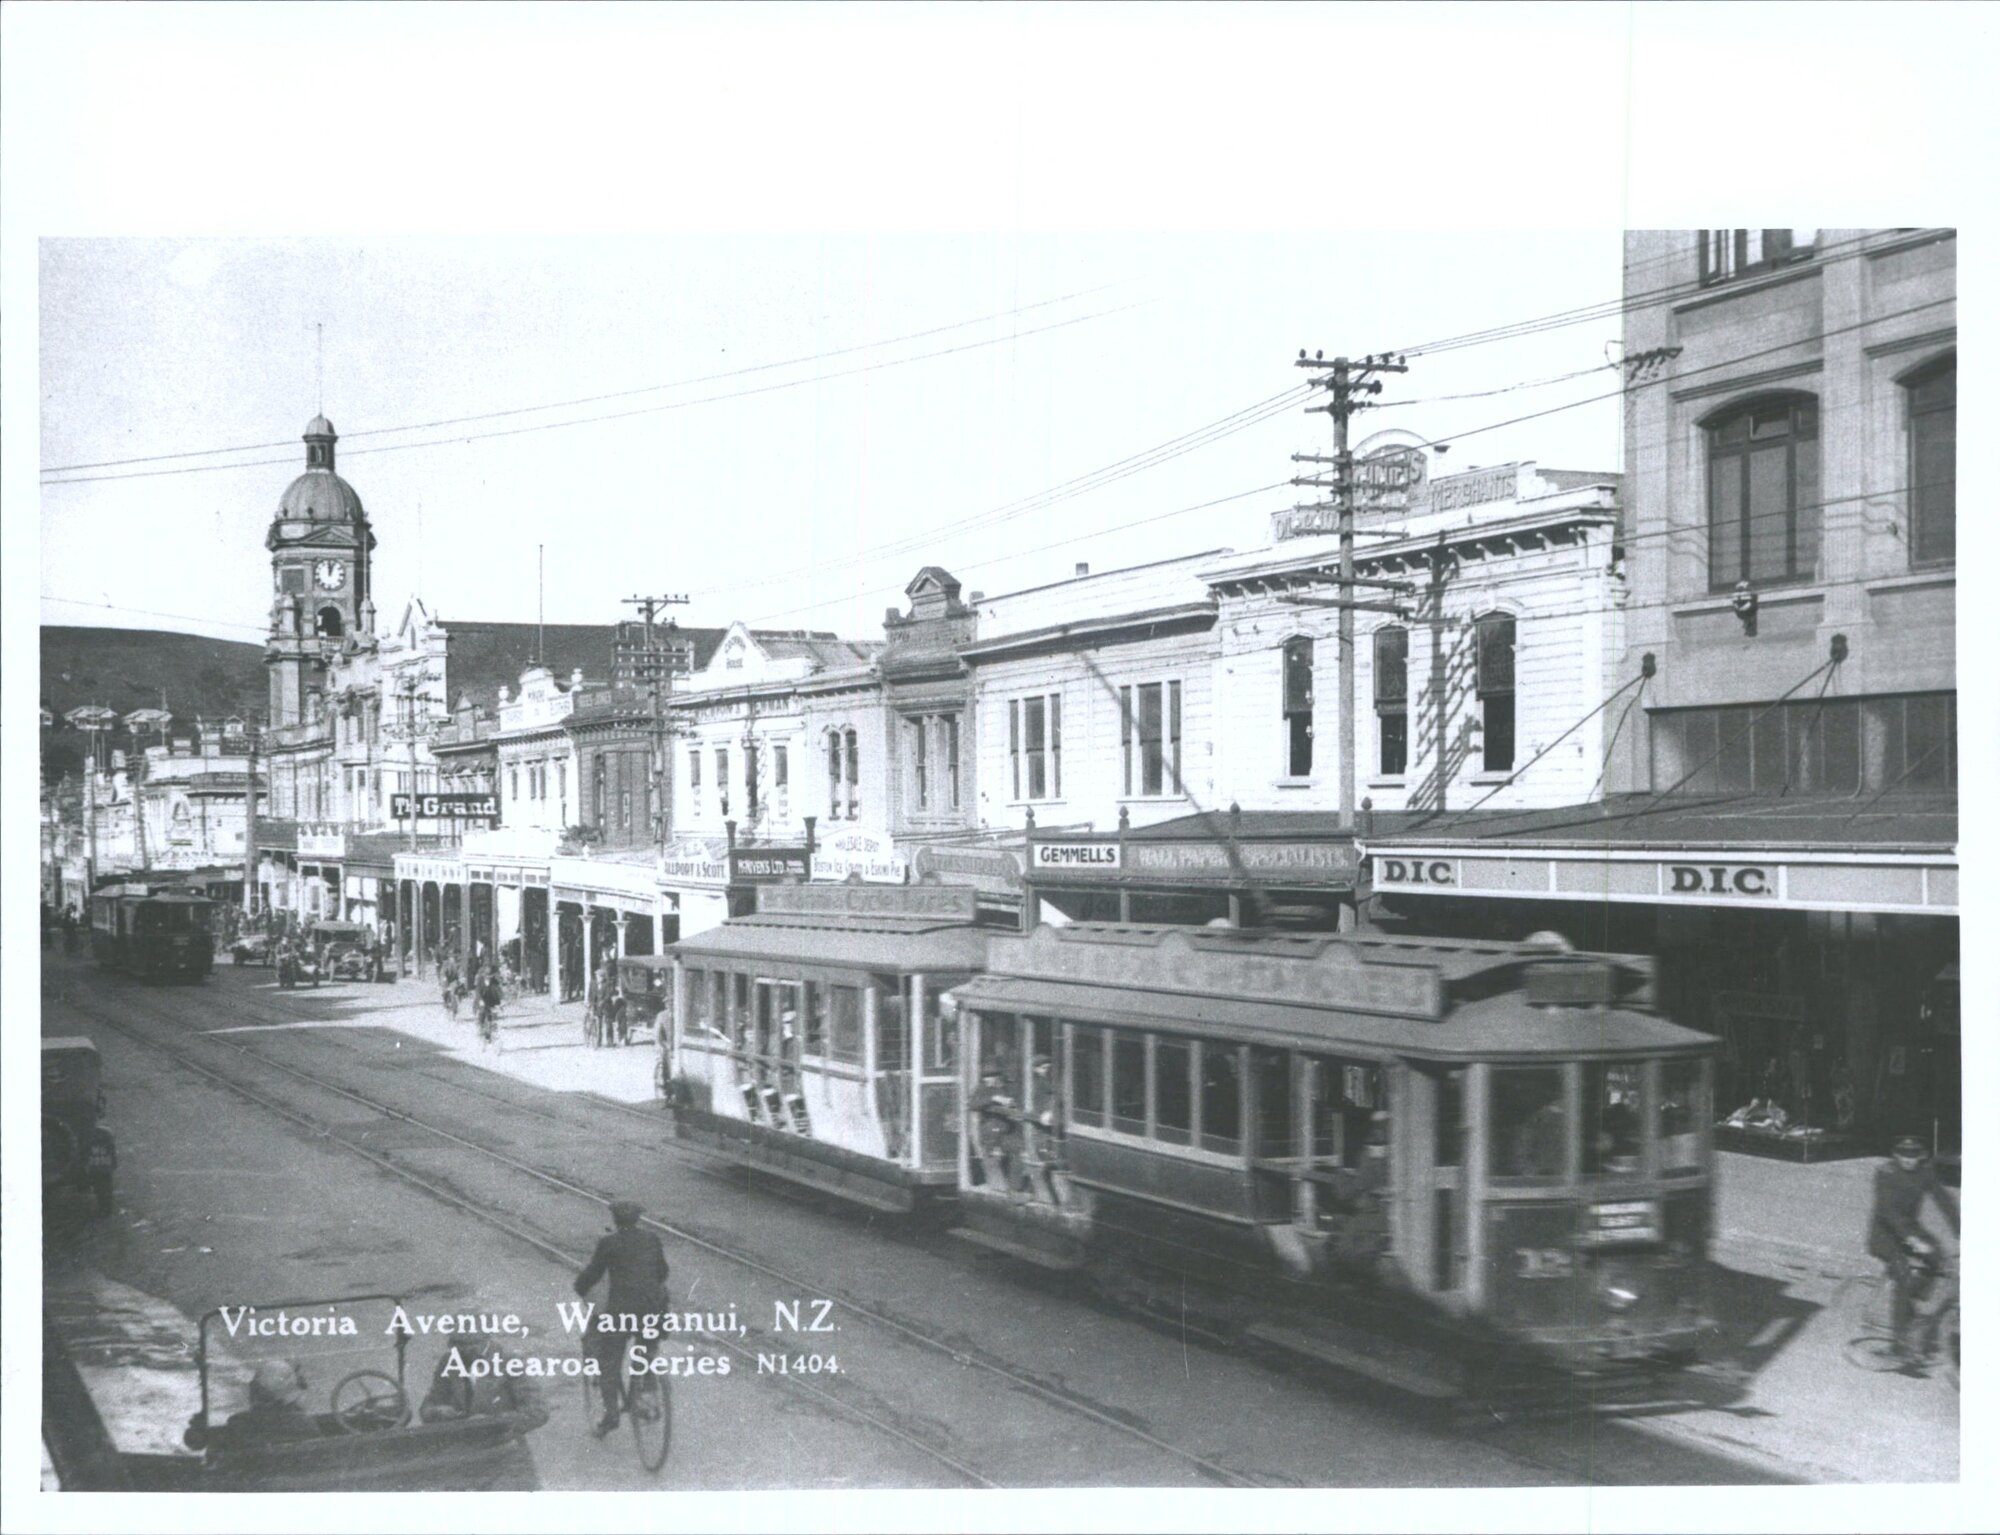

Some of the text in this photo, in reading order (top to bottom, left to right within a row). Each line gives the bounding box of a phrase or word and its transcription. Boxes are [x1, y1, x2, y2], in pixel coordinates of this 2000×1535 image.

[423, 797, 498, 816] Grand
[1041, 846, 1115, 863] GEMMELL'S
[1384, 860, 1455, 884] D.I.C.
[1671, 866, 1772, 894] D.I.C.
